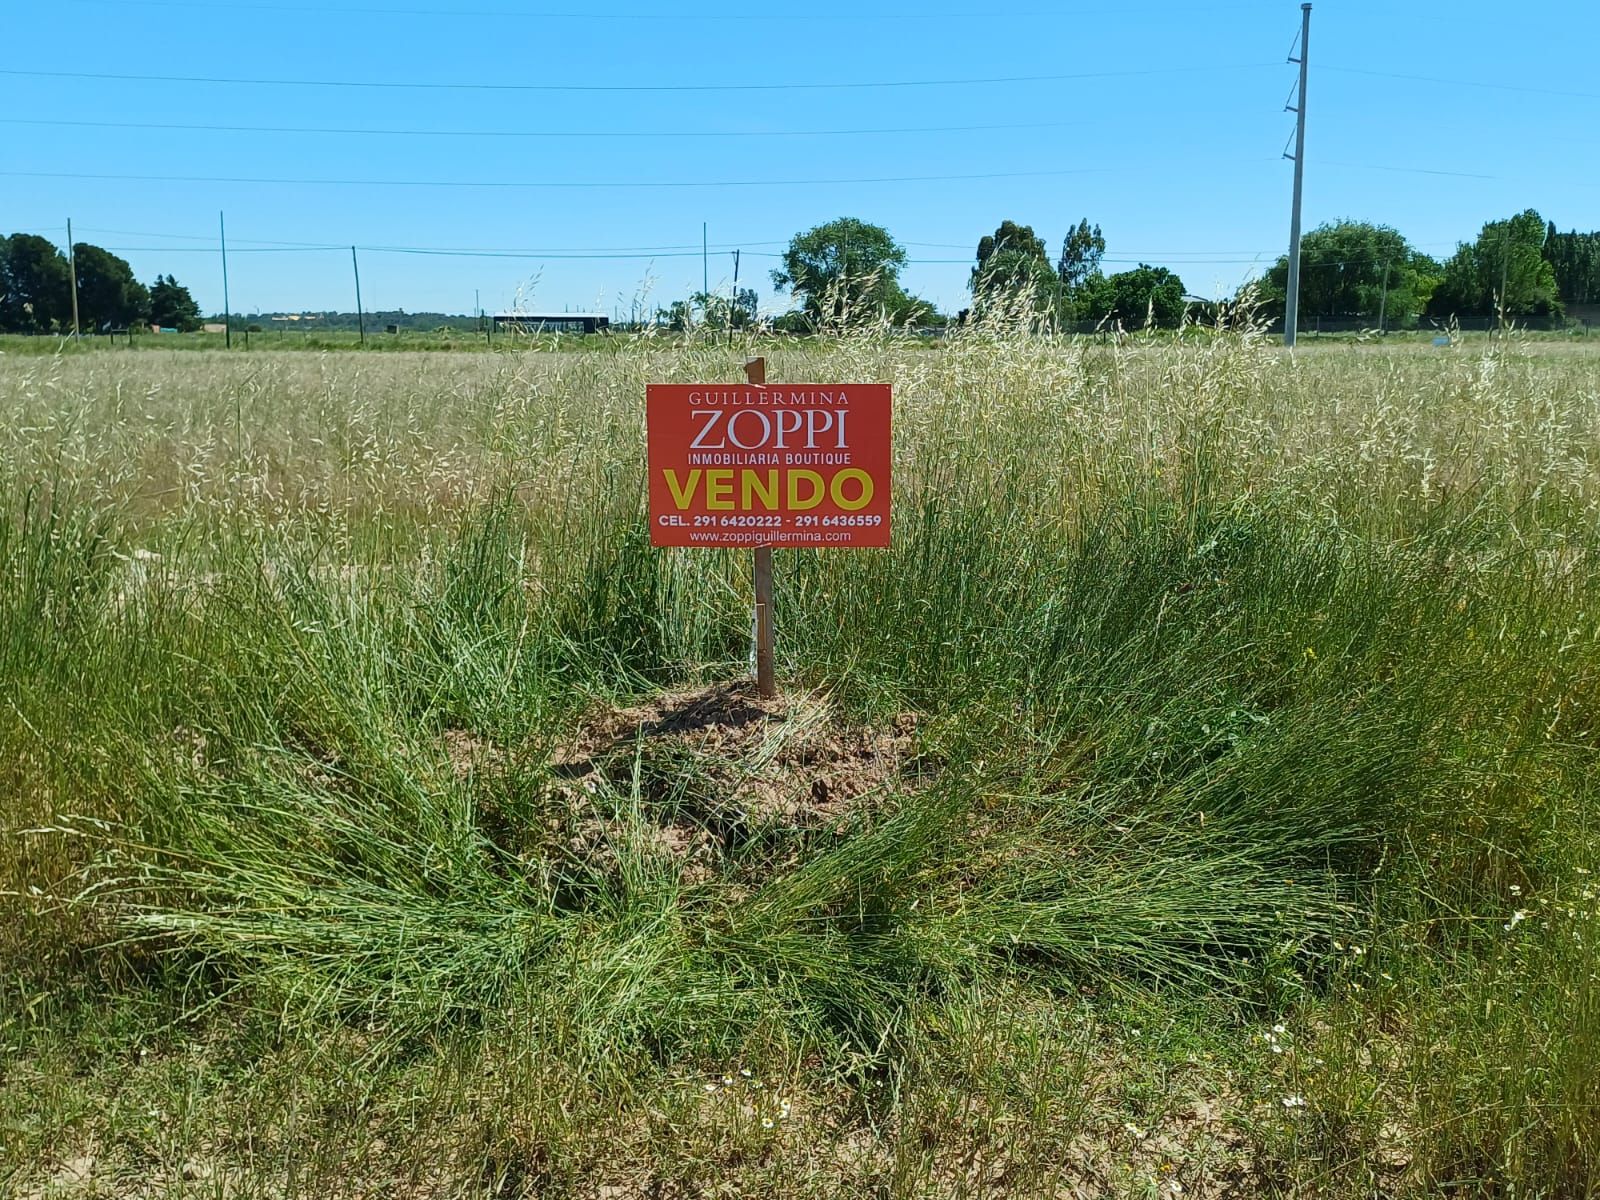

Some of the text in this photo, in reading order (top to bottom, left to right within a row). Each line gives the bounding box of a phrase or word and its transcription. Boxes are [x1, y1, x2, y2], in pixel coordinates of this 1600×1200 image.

[688, 391, 849, 405] GUILLERMINA
[689, 409, 850, 450] ZOPPI
[688, 453, 851, 465] INMOBILIARIA BOUTIQUE
[662, 467, 875, 511] VENDO
[658, 515, 690, 527] CEL.
[694, 515, 717, 527] 291
[720, 515, 782, 527] 6420222
[795, 515, 818, 527] 291
[822, 515, 882, 527] 6436559
[689, 530, 851, 544] www.zoppiguillermina.com
